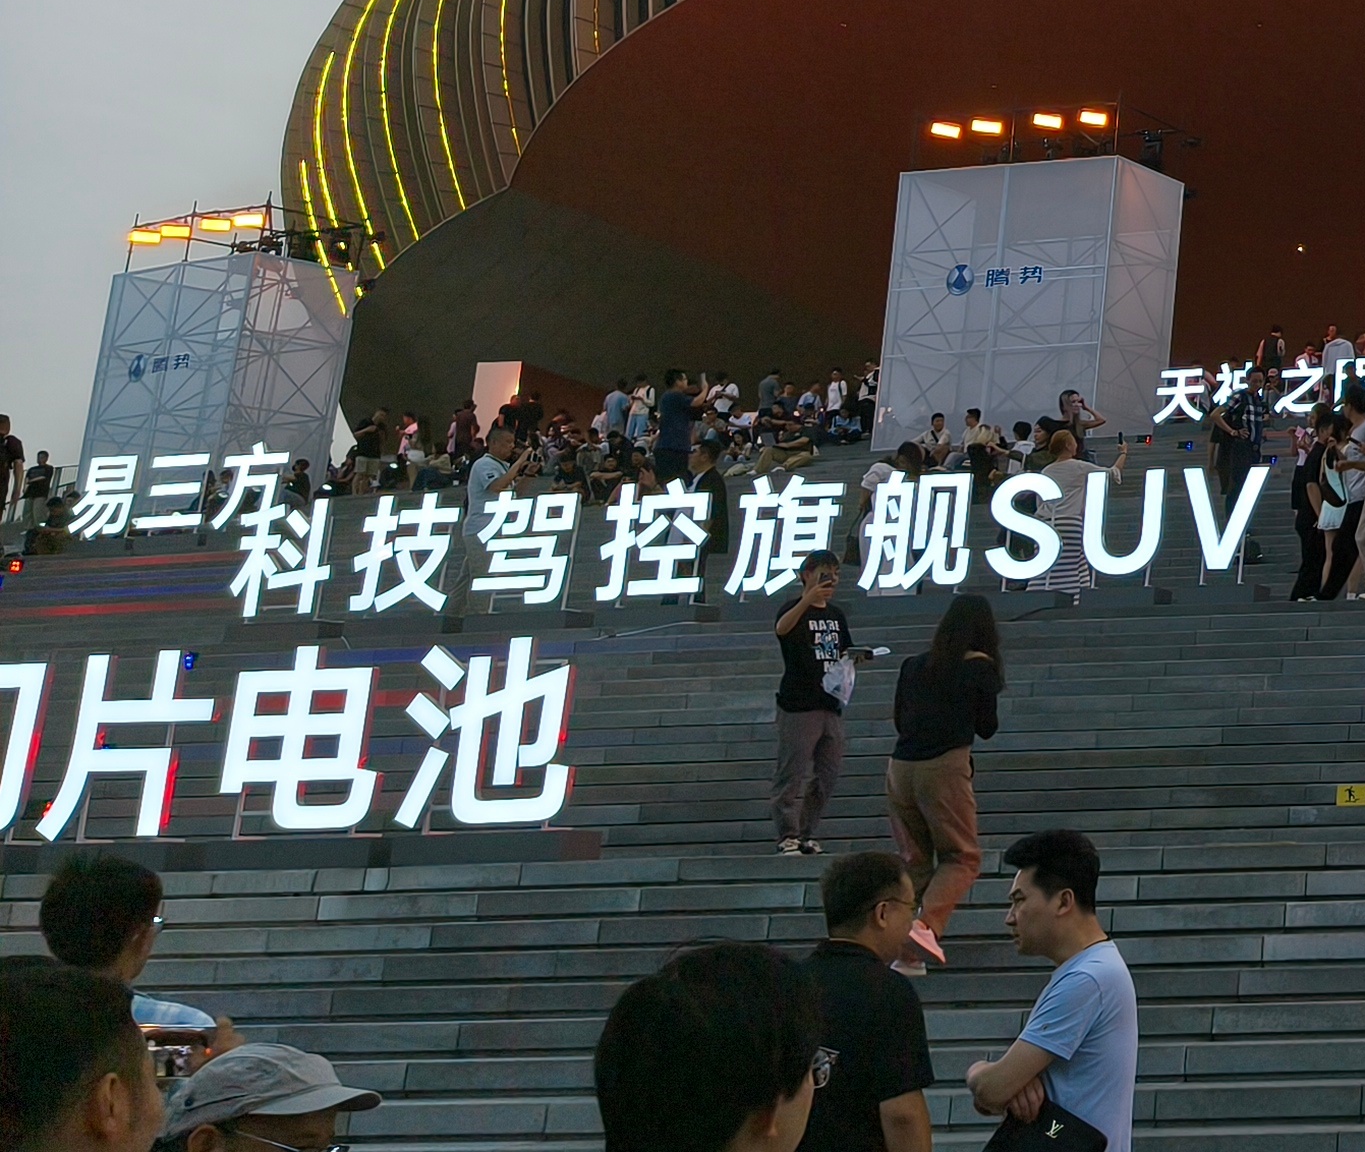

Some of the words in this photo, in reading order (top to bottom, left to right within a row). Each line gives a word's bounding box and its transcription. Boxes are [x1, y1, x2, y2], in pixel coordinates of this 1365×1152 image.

[67, 441, 290, 540] 易三方
[228, 464, 1271, 619] 科技驾控旗舰SUV
